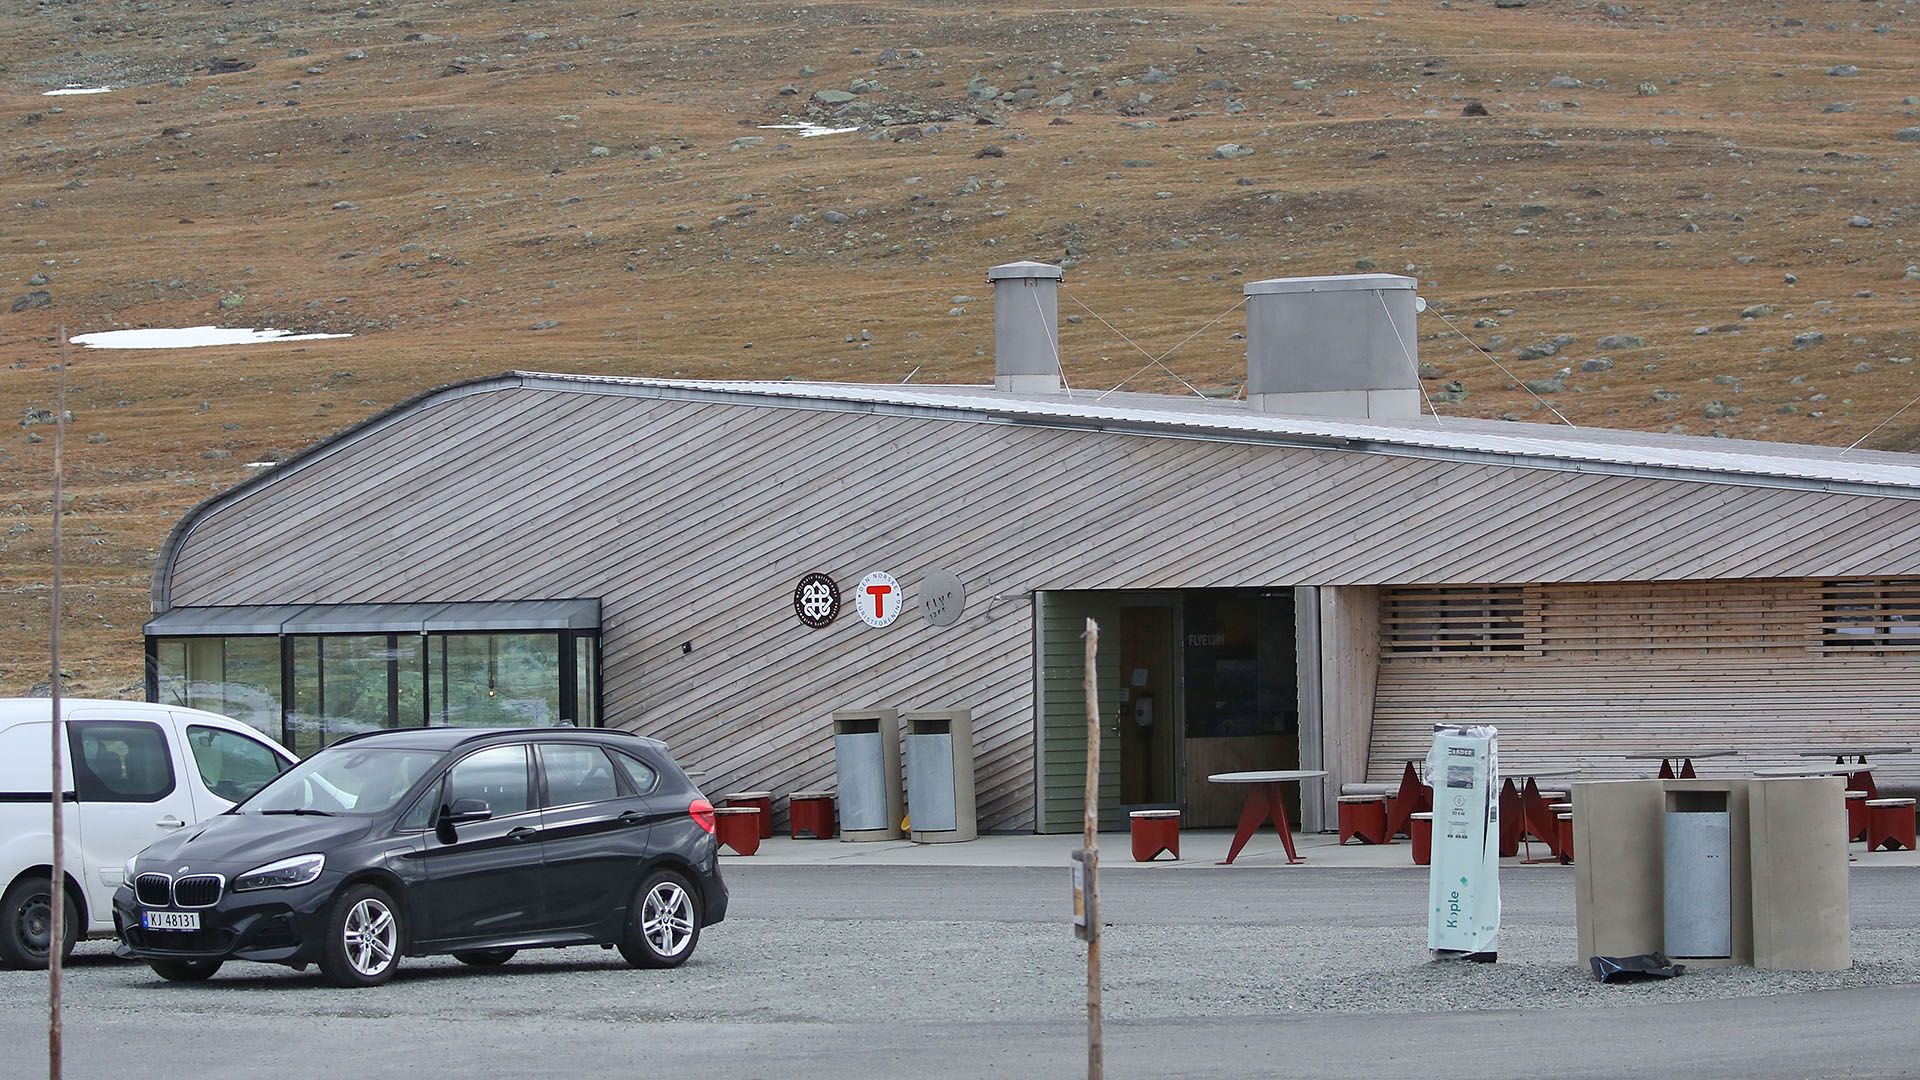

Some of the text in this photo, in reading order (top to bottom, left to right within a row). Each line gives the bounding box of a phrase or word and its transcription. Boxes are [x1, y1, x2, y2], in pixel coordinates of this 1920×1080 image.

[866, 585, 892, 619] T
[151, 913, 195, 927] KJ 48131
